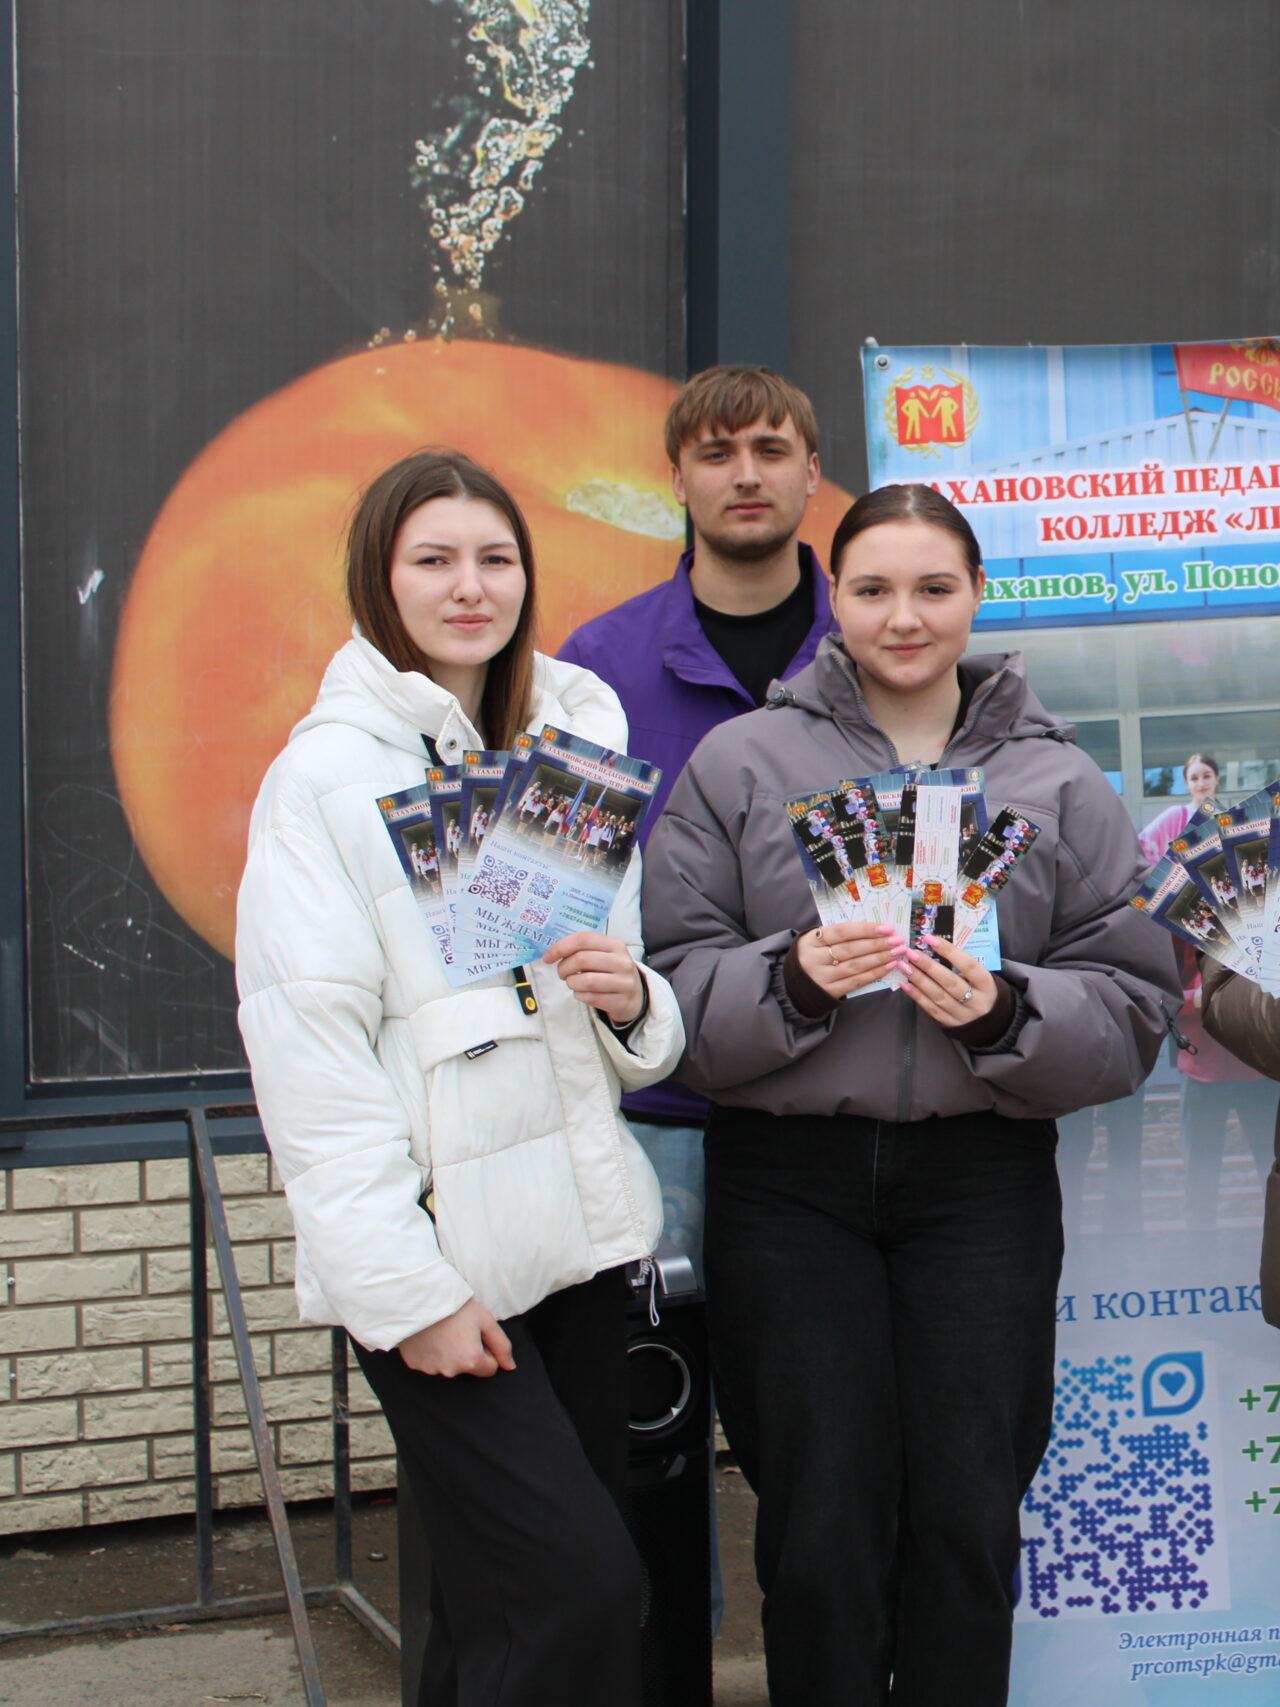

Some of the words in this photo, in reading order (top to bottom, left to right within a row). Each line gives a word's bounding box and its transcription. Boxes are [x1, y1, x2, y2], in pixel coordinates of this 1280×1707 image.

[930, 464, 1165, 505] ХАНОВСКИЙ
[1041, 508, 1218, 542] КОЛЛЕДЖ
[980, 573, 1116, 602] аханов,
[1123, 571, 1177, 602] ул.
[475, 906, 500, 924] МЫ
[1092, 1285, 1261, 1320] контак
[1118, 1628, 1261, 1650] Электронная
